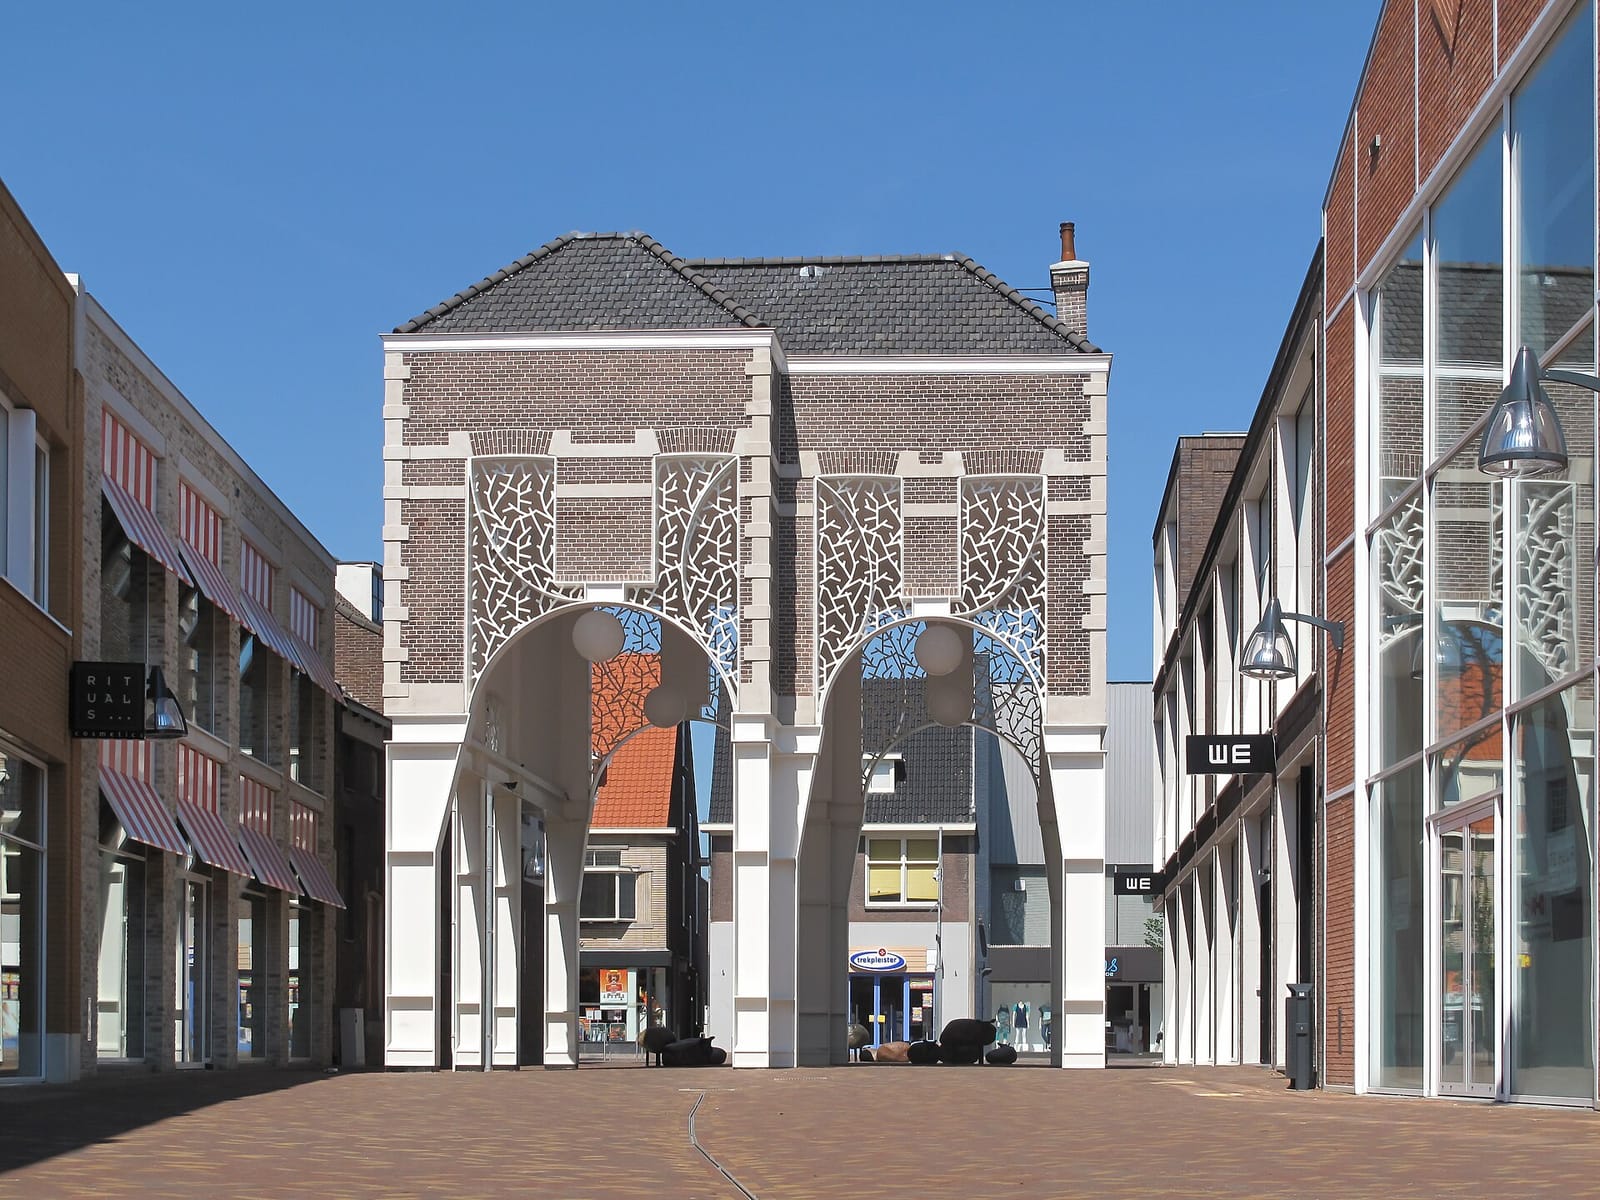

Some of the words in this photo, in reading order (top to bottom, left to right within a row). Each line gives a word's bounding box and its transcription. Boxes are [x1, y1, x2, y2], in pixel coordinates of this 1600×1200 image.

[1208, 743, 1251, 764] WE
[1126, 877, 1151, 890] WE
[857, 956, 897, 965] trekpleister
